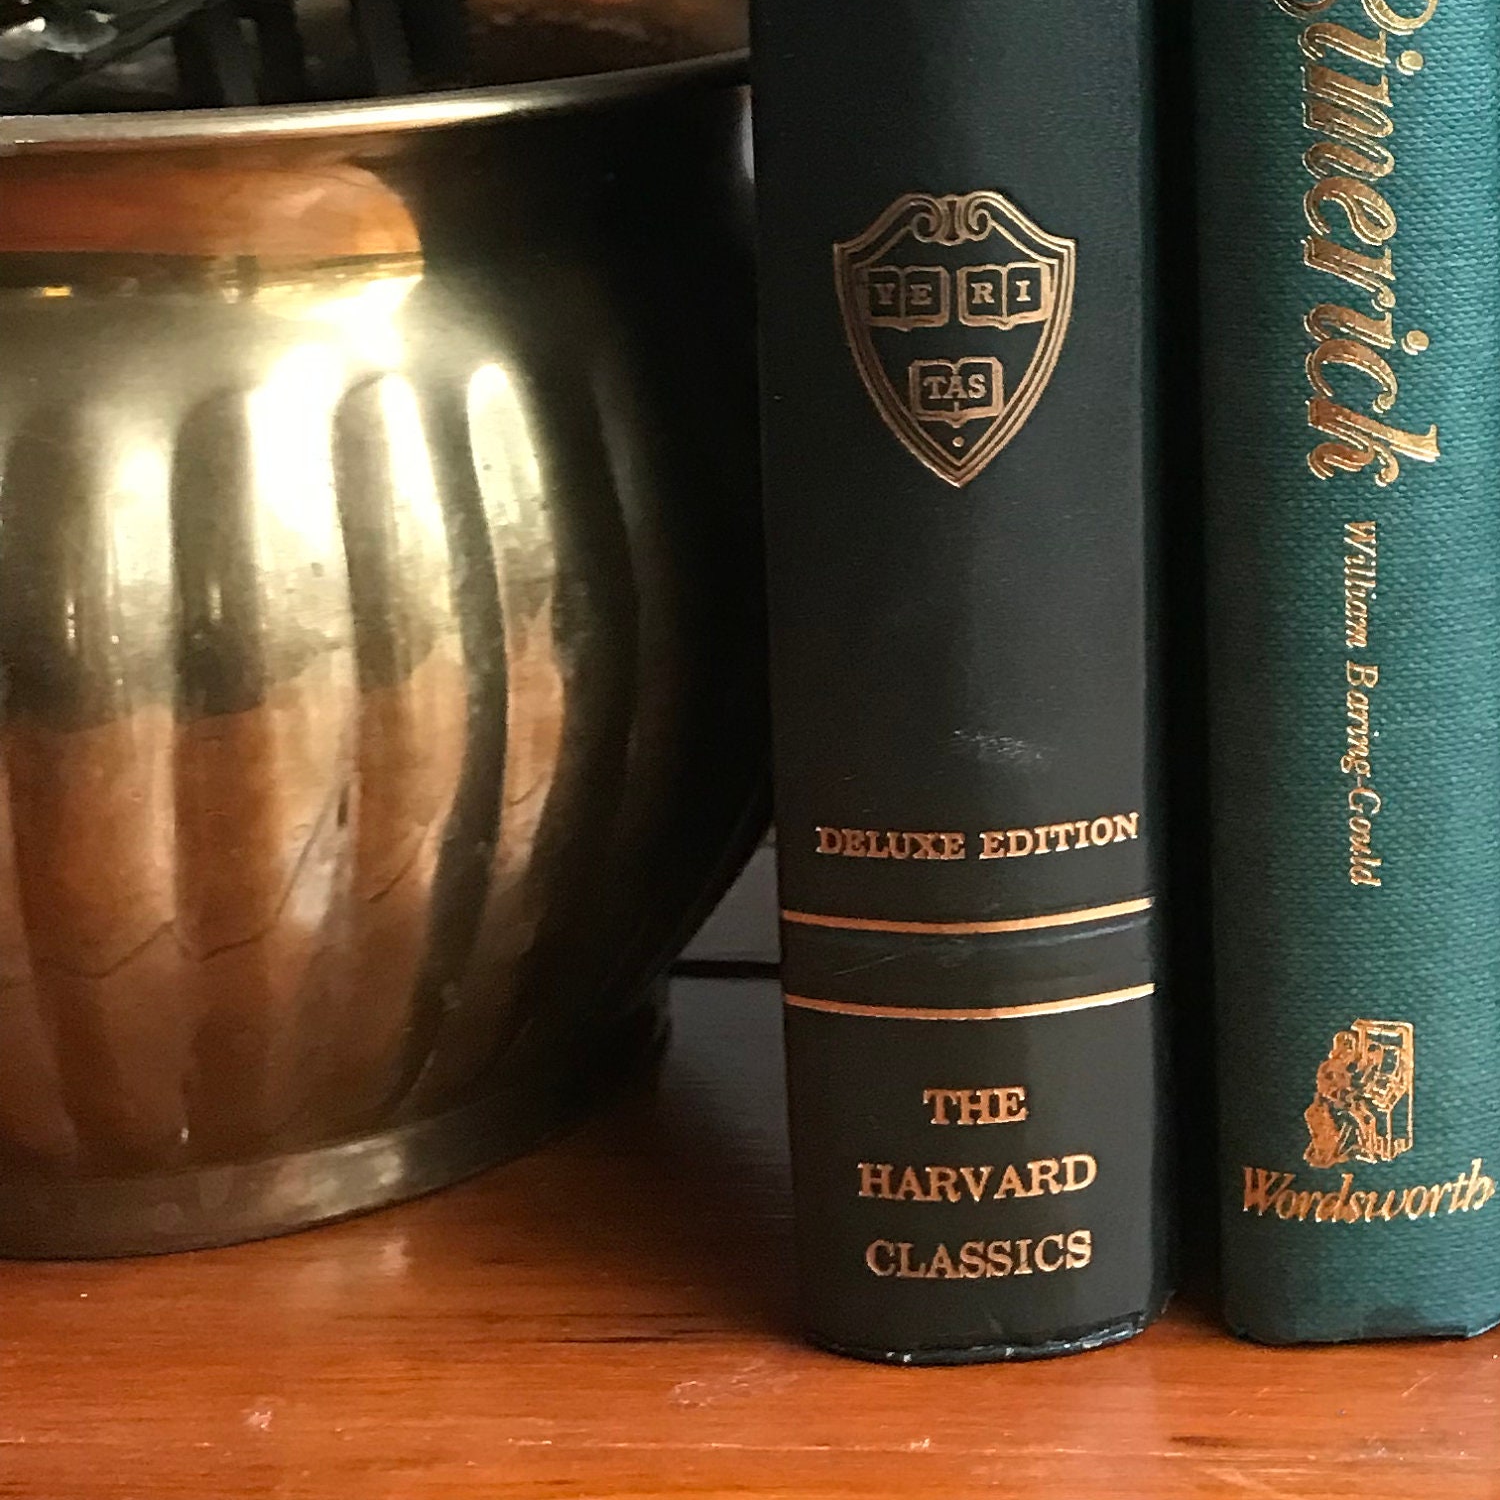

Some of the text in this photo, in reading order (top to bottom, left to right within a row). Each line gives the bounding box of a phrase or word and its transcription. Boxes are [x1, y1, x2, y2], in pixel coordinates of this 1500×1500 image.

[1340, 520, 1383, 888] William Baring-Gould
[815, 811, 1140, 860] DELUXE EDITION
[921, 1085, 1029, 1126] THE
[857, 1153, 1098, 1202] HARVARD
[1241, 1159, 1496, 1223] Wordsworth
[864, 1228, 1093, 1279] CLASSICS
